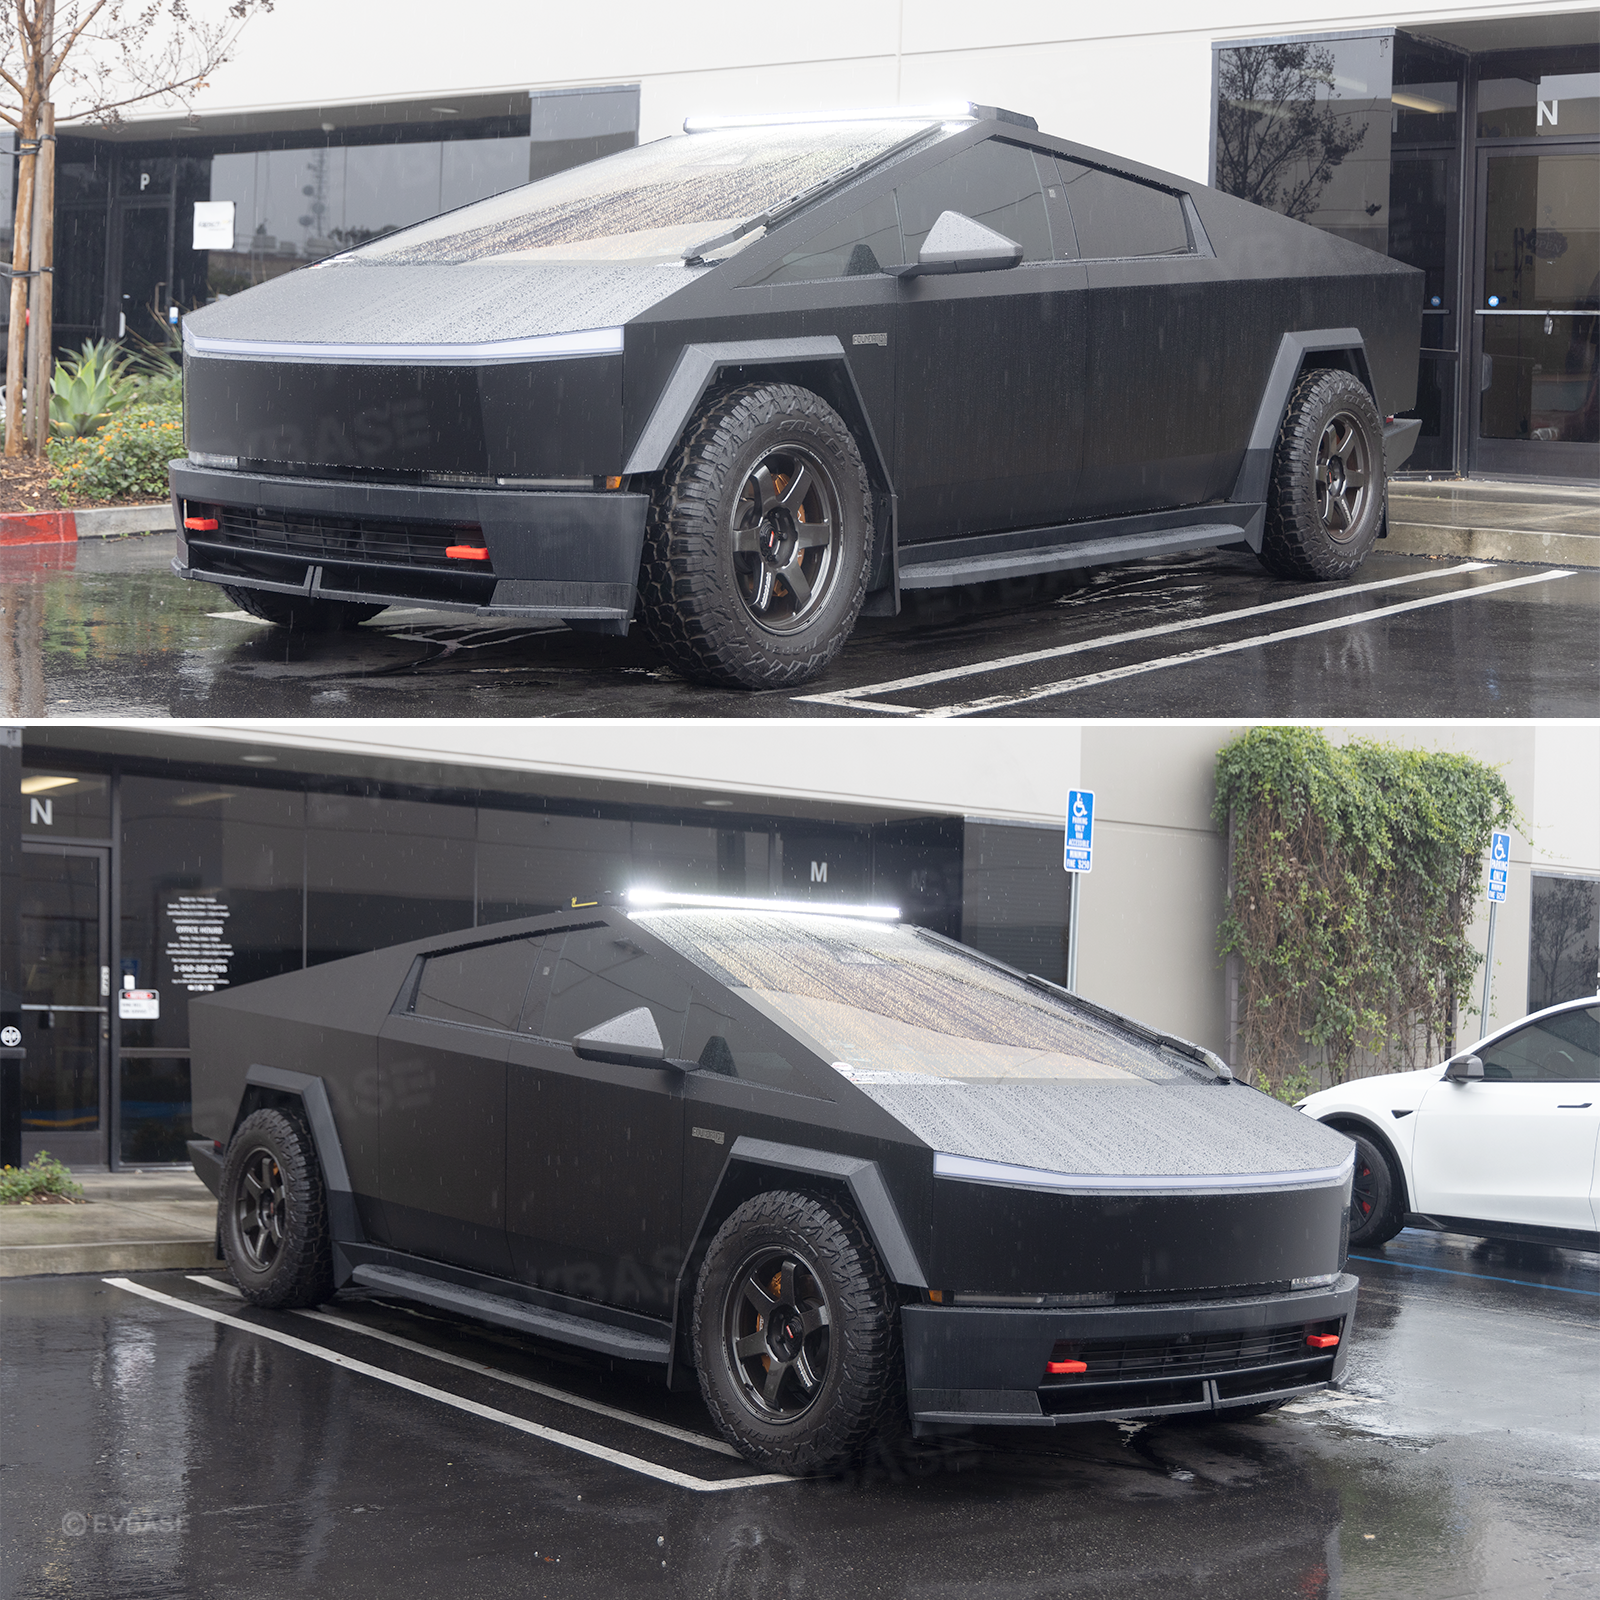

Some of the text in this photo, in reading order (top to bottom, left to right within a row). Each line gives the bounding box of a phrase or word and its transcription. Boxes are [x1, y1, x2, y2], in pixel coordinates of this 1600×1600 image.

[1537, 100, 1558, 126] N
[140, 172, 150, 191] P
[30, 797, 53, 825] N
[1072, 816, 1088, 825] PARKING
[1074, 824, 1085, 832] ONLY
[810, 860, 827, 883] M
[1066, 858, 1090, 870] FINE $250
[1493, 870, 1504, 881] ONLY
